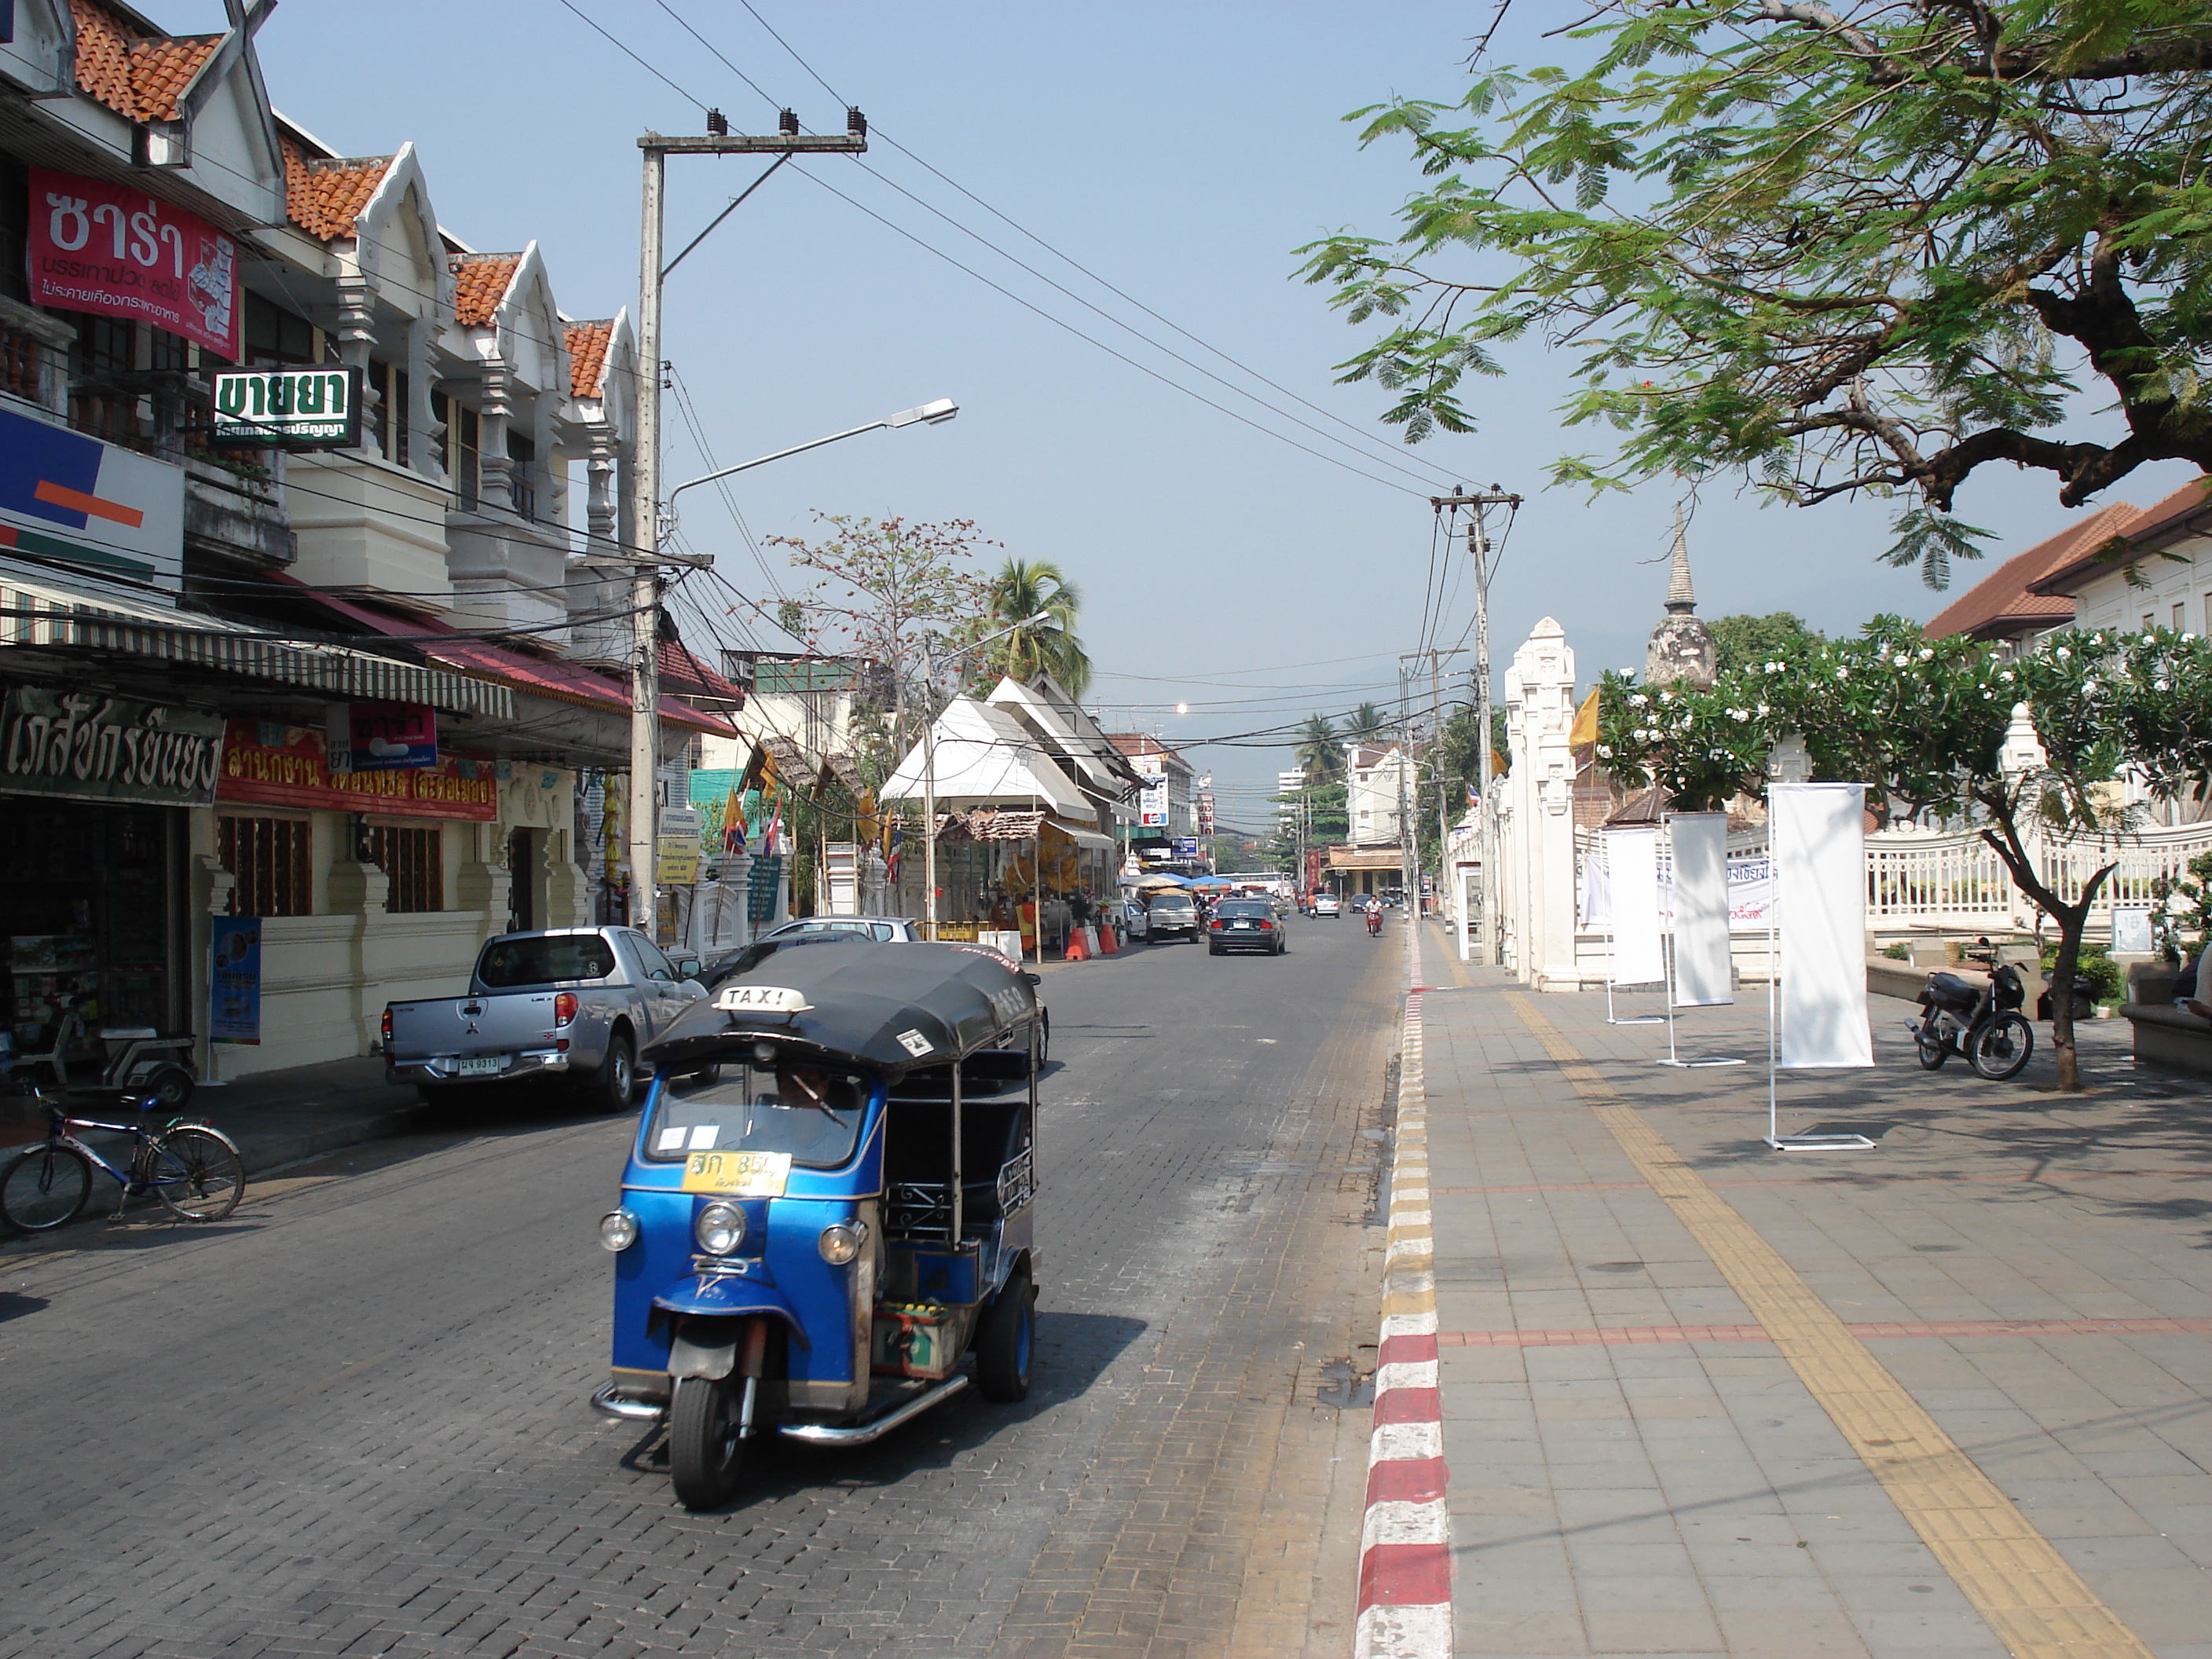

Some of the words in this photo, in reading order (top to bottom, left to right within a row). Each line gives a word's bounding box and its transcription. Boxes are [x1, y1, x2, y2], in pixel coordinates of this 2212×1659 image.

[46, 192, 182, 279] ซาร่า
[42, 257, 146, 288] บรรเทาปวด
[219, 374, 345, 416] ขายยา
[353, 705, 423, 738] ซาร่า
[227, 730, 320, 787] สำนกงาน
[330, 750, 351, 768] ยา
[477, 1058, 497, 1068] 9313
